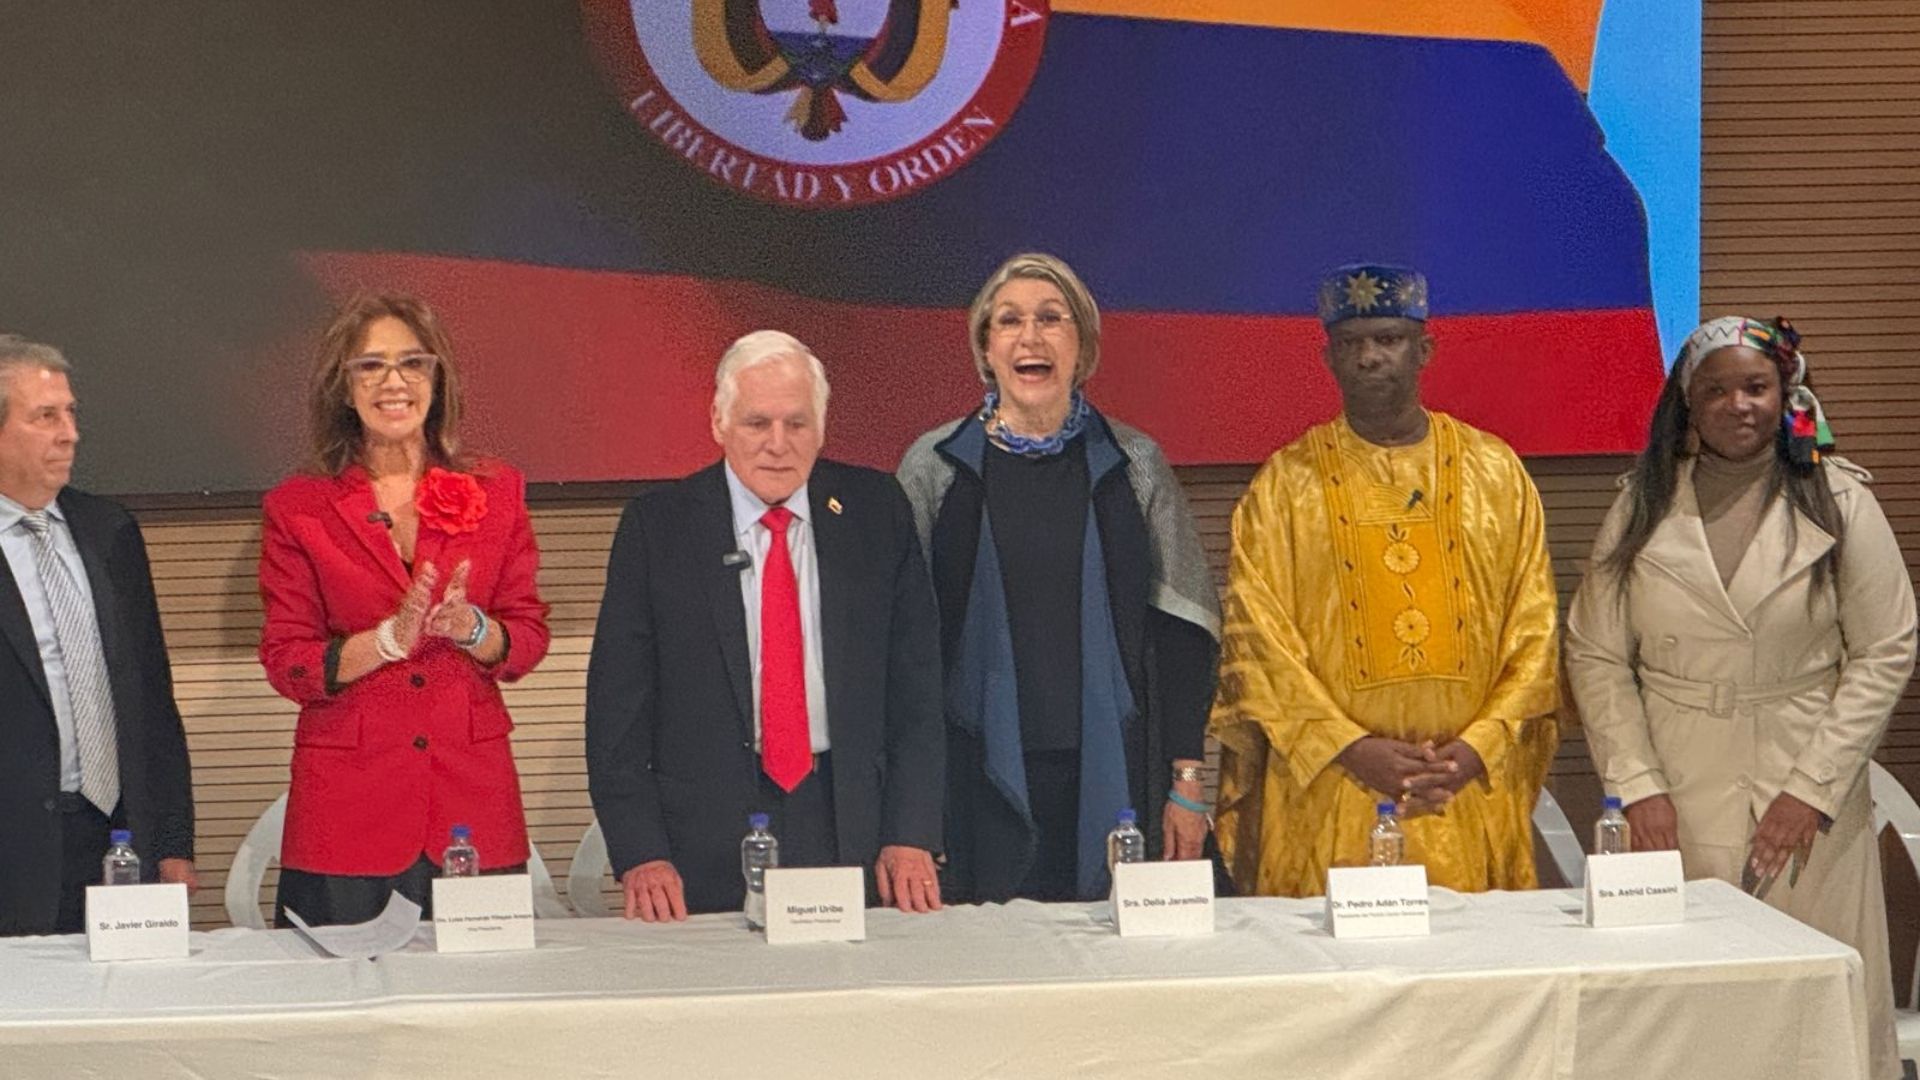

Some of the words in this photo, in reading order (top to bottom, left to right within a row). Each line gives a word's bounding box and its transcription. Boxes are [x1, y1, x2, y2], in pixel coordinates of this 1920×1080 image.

[831, 172, 855, 200] Y
[868, 105, 996, 195] ORDEN
[1618, 888, 1645, 897] Astrid
[1646, 886, 1679, 895] Cassini
[1143, 898, 1166, 907] Delia
[1168, 896, 1209, 906] Jaramillo
[1332, 901, 1345, 909] Dr.
[1347, 900, 1373, 908] Pedro
[1400, 898, 1430, 907] Torres
[786, 905, 818, 915] Miguel
[819, 905, 844, 914] Uribe
[99, 922, 113, 931] Sr.
[115, 921, 142, 931] Javier
[144, 920, 179, 930] Giraldo
